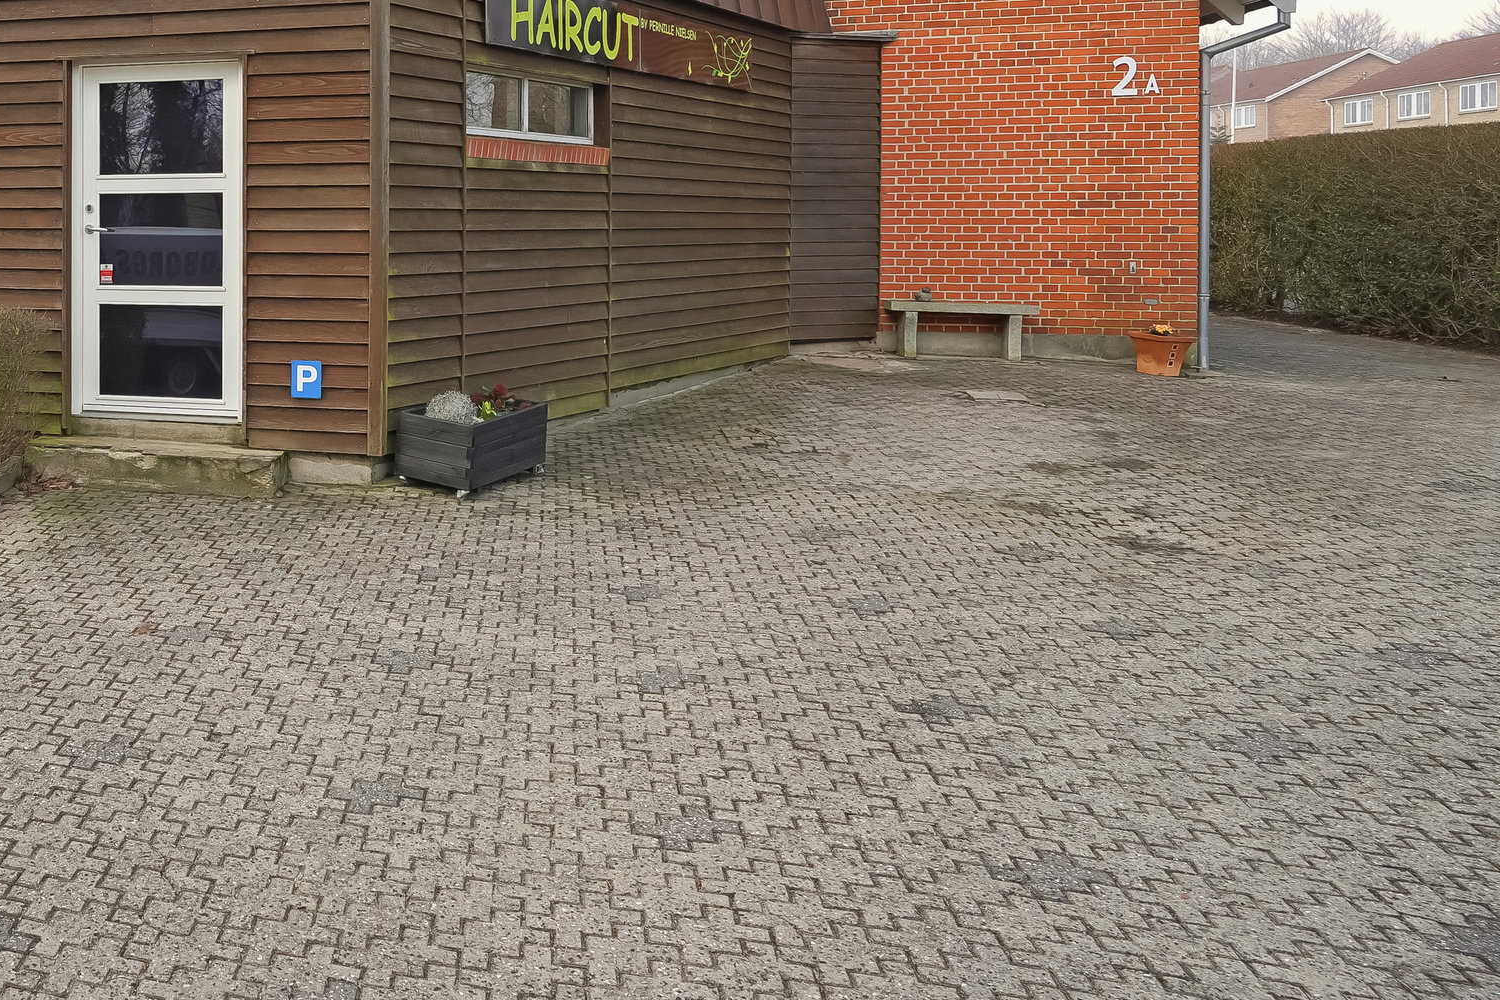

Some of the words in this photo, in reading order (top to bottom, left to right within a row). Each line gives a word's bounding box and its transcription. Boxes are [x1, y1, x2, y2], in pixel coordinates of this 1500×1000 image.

[641, 18, 648, 29] BY
[649, 20, 675, 36] PERNILLE
[675, 26, 697, 41] NIELSEN
[297, 365, 318, 392] P
